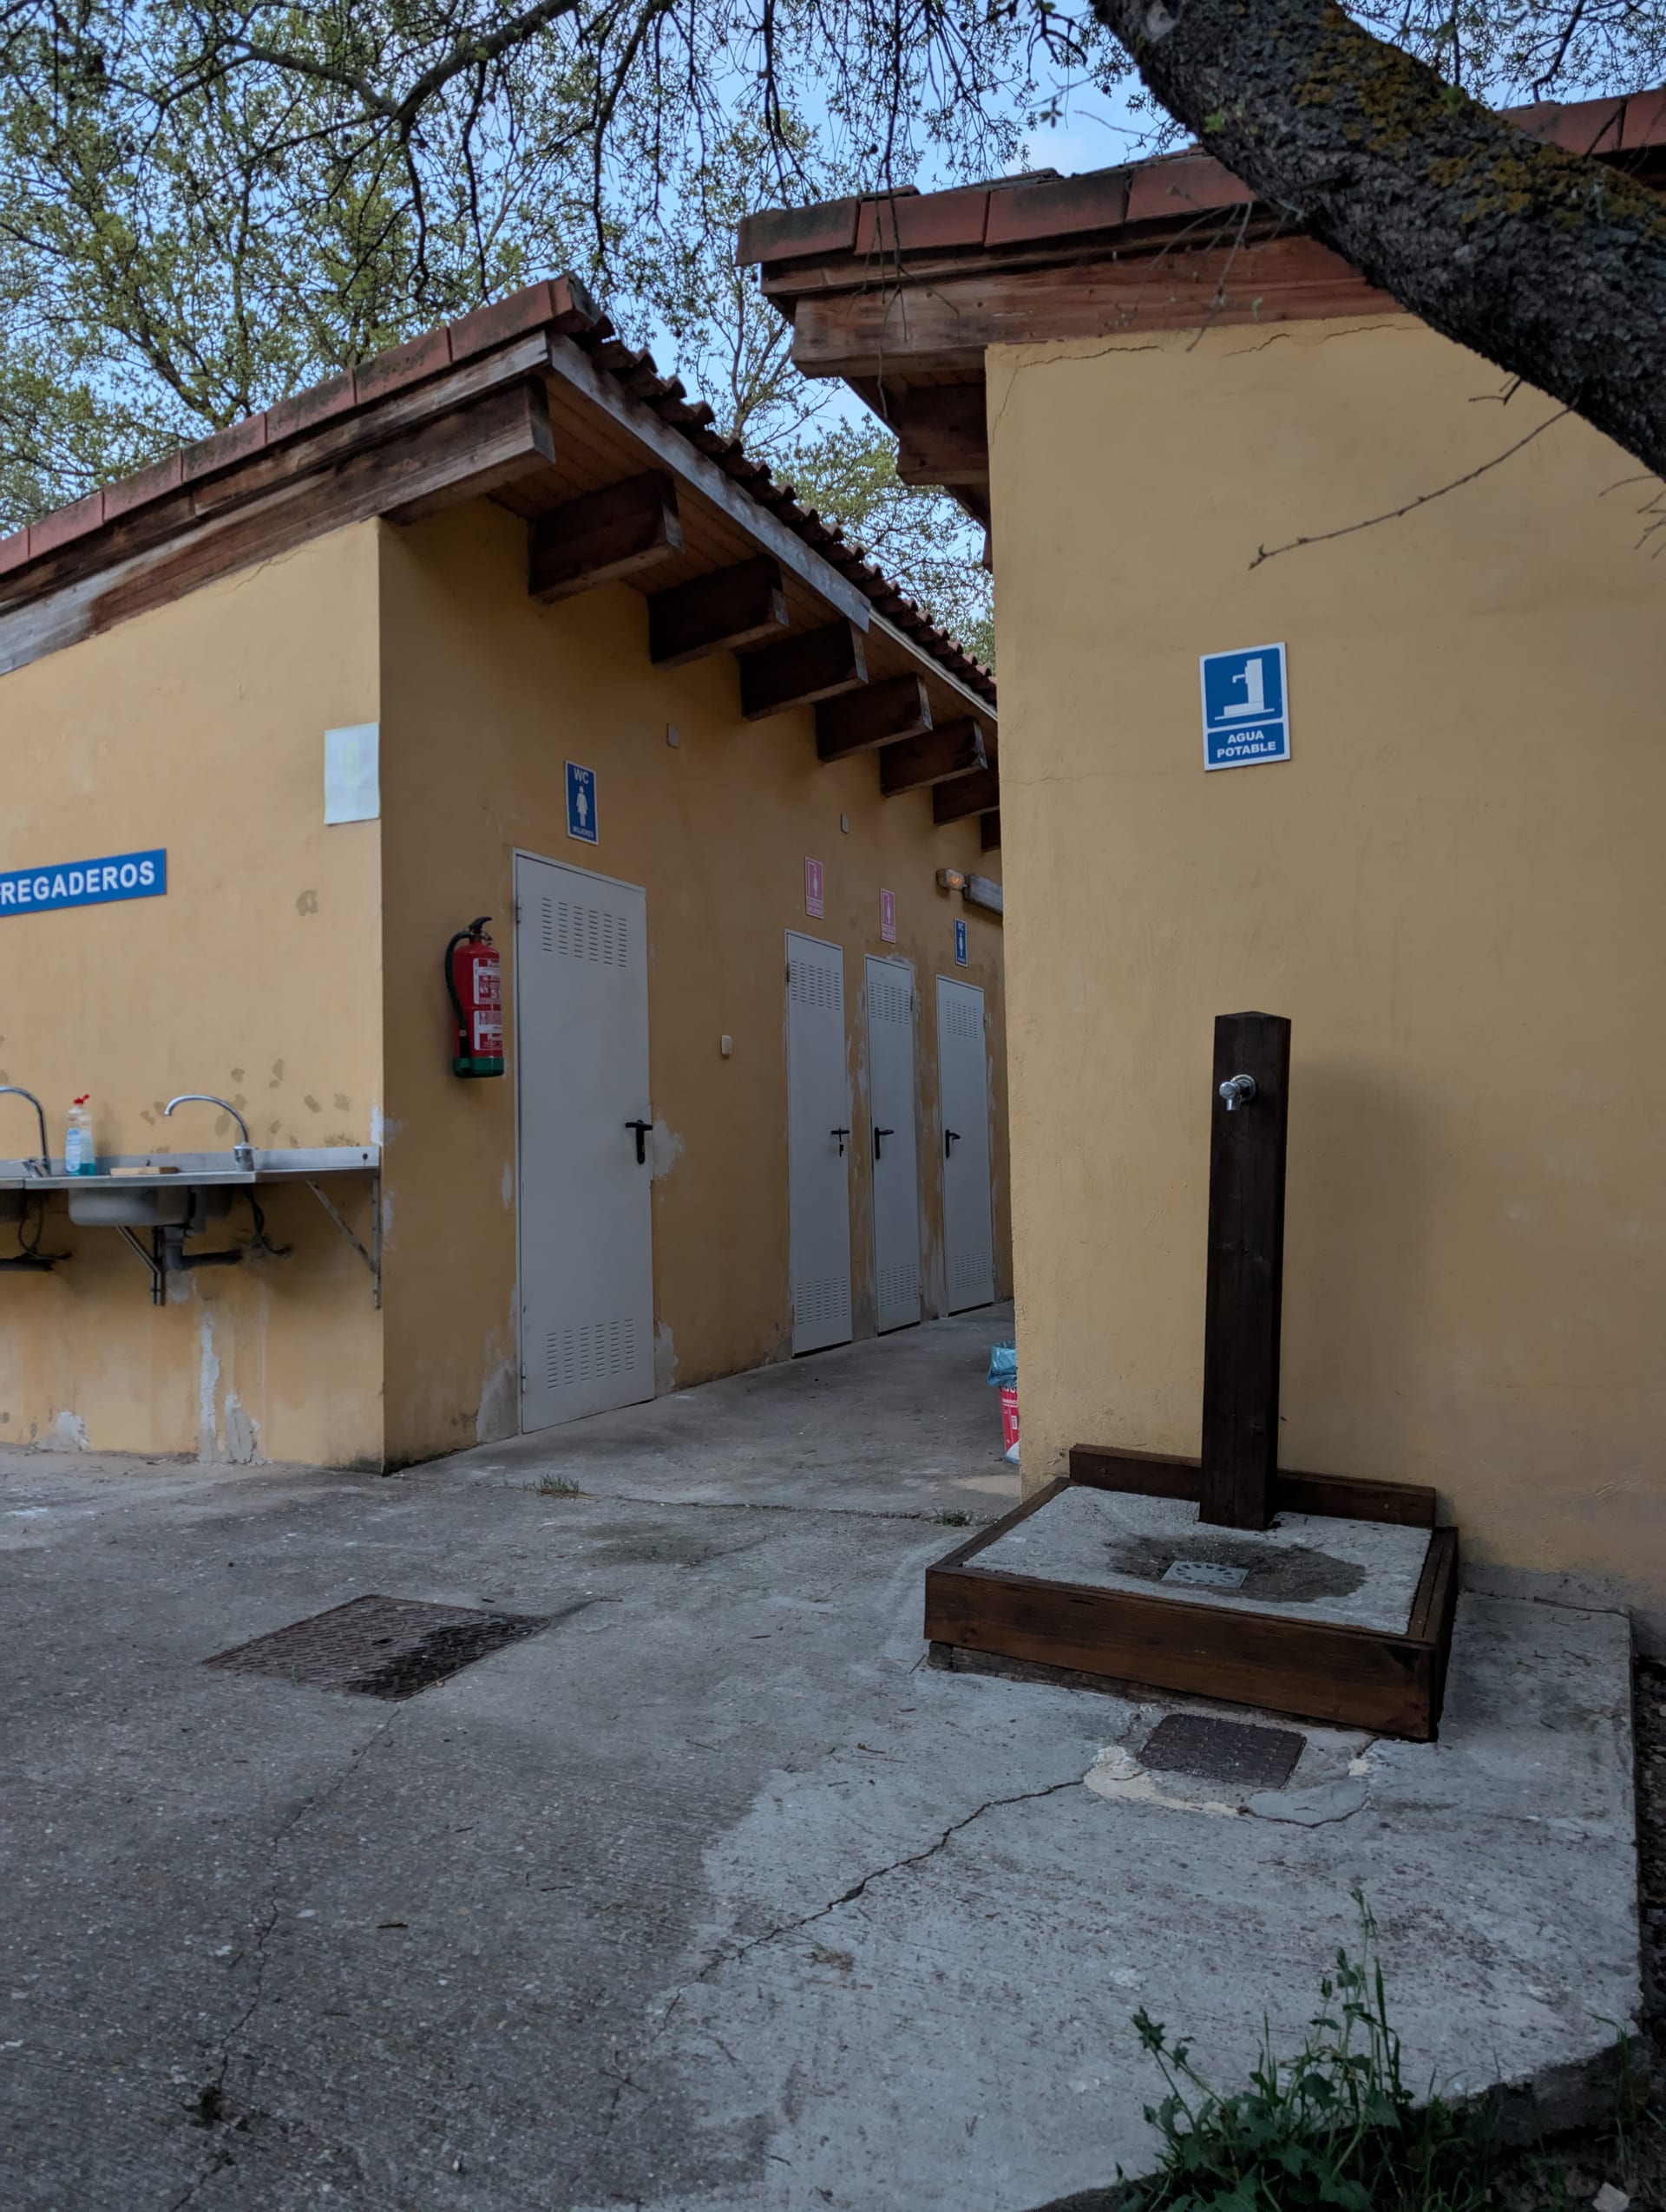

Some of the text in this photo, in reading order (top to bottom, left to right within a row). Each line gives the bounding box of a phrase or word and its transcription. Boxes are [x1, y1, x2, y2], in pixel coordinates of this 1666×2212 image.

[1228, 730, 1264, 744] AGUA
[1217, 742, 1276, 758] POTABLE
[573, 767, 590, 784] WC
[0, 861, 155, 906] REGADEROS
